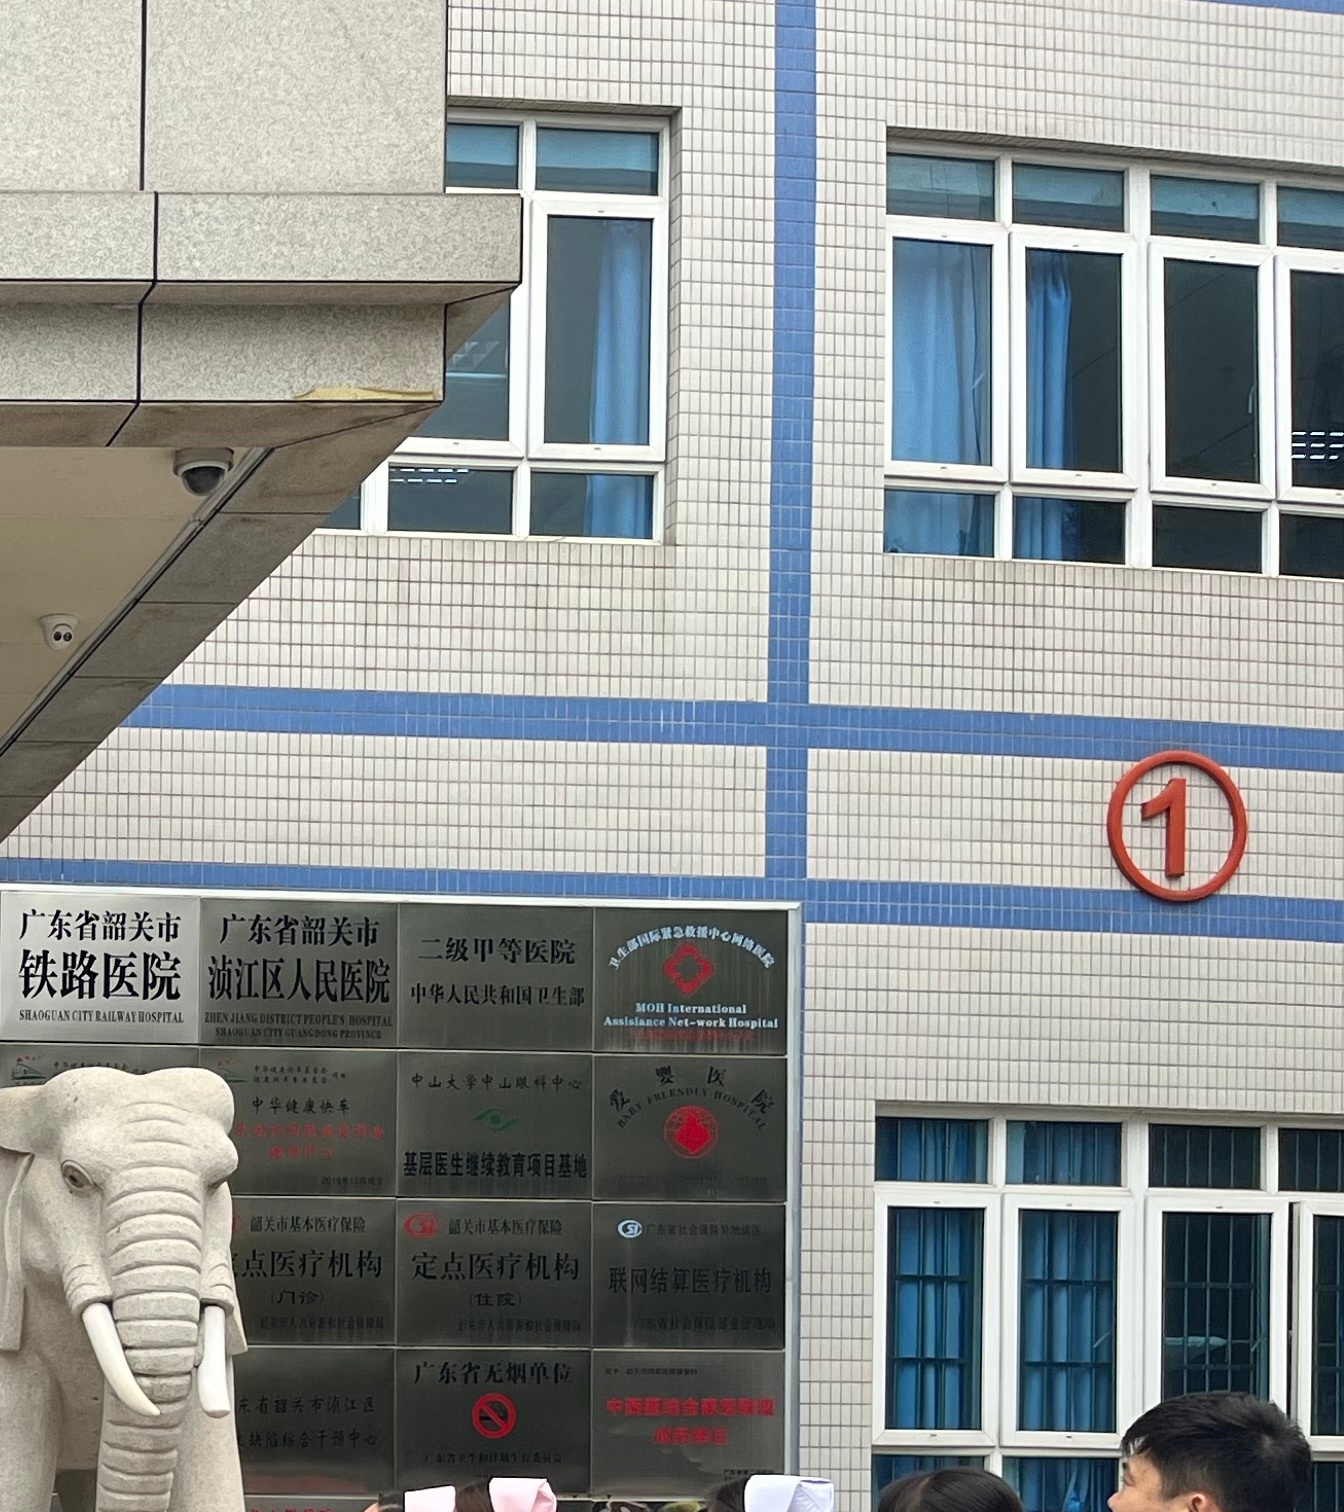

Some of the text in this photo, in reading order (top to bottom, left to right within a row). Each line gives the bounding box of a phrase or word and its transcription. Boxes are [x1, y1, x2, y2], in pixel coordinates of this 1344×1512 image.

[1140, 778, 1186, 878] 1
[19, 909, 182, 942] 广东省韶关市
[219, 913, 379, 948] 广东省韶关市
[418, 937, 576, 966] 二级甲等医院
[18, 948, 182, 1001] 铁路医院
[207, 955, 391, 1004] 浈江区人民医院
[411, 982, 585, 1007] 中华人民共和国卫生部
[19, 1010, 184, 1024] SHAOGUAN CITY RAILWAY HOSPITAL
[259, 1013, 302, 1026] DISTRICT
[348, 1014, 394, 1027] HOSPITAL
[635, 1002, 747, 1015] MOH International
[263, 1028, 284, 1039] CITY
[728, 1017, 779, 1030] Hospital
[411, 1073, 584, 1092] 中山大学中山眼科中心
[252, 1096, 351, 1117] 中华健康快车
[617, 1101, 643, 1129] BABY
[713, 1090, 768, 1132] HOSPITAL
[403, 1151, 588, 1179] 基层医生继续教育项目基地
[250, 1216, 366, 1234] 韶关市基本医疗保险
[448, 1217, 563, 1236] 韶关市基本医疗保险
[233, 1249, 383, 1280] 点医疗机构
[412, 1251, 580, 1281] 定点医疗机构
[608, 1266, 772, 1295] 联网结算医疗机构
[414, 1361, 573, 1385] 广东省无烟单位
